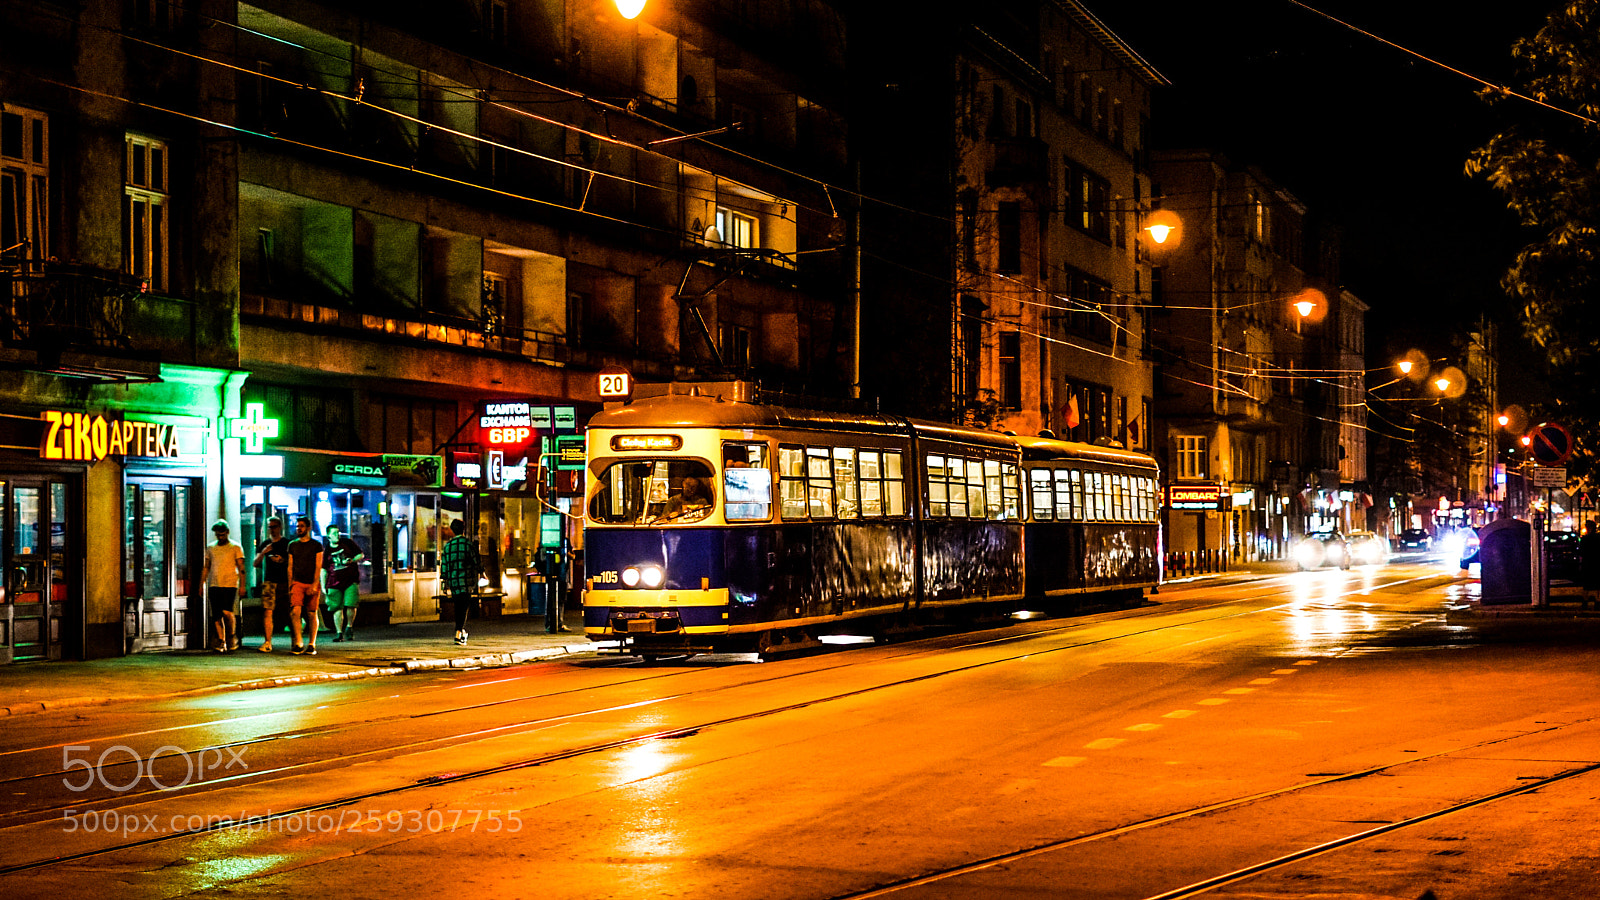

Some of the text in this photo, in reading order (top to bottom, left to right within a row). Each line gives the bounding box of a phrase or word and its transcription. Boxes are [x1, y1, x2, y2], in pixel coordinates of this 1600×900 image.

[603, 376, 623, 393] 20
[480, 415, 531, 428] EXCHANG
[109, 419, 180, 457] APTEKA
[335, 464, 383, 476] GERDA
